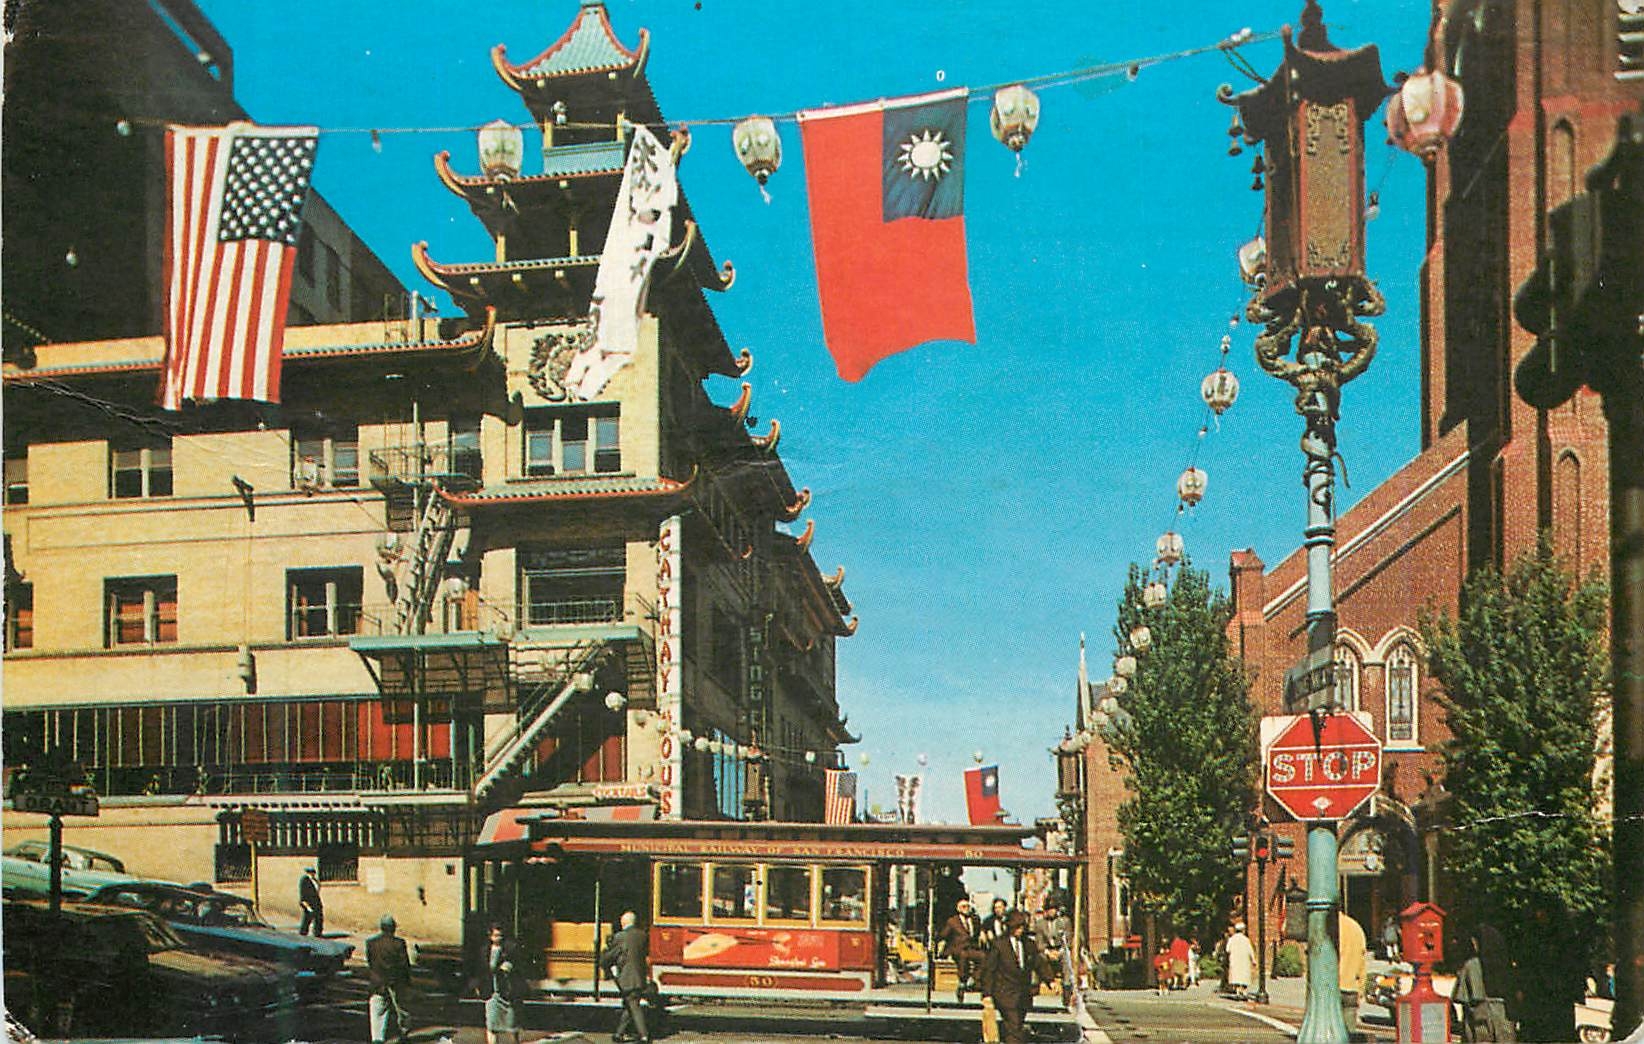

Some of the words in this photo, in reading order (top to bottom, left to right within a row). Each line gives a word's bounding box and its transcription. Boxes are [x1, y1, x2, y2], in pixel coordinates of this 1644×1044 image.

[660, 528, 672, 693] CATHAY
[1272, 751, 1377, 783] STOP
[700, 845, 759, 854] RAILWAY
[793, 847, 818, 856] SAN
[826, 848, 905, 857] FRANCISCO
